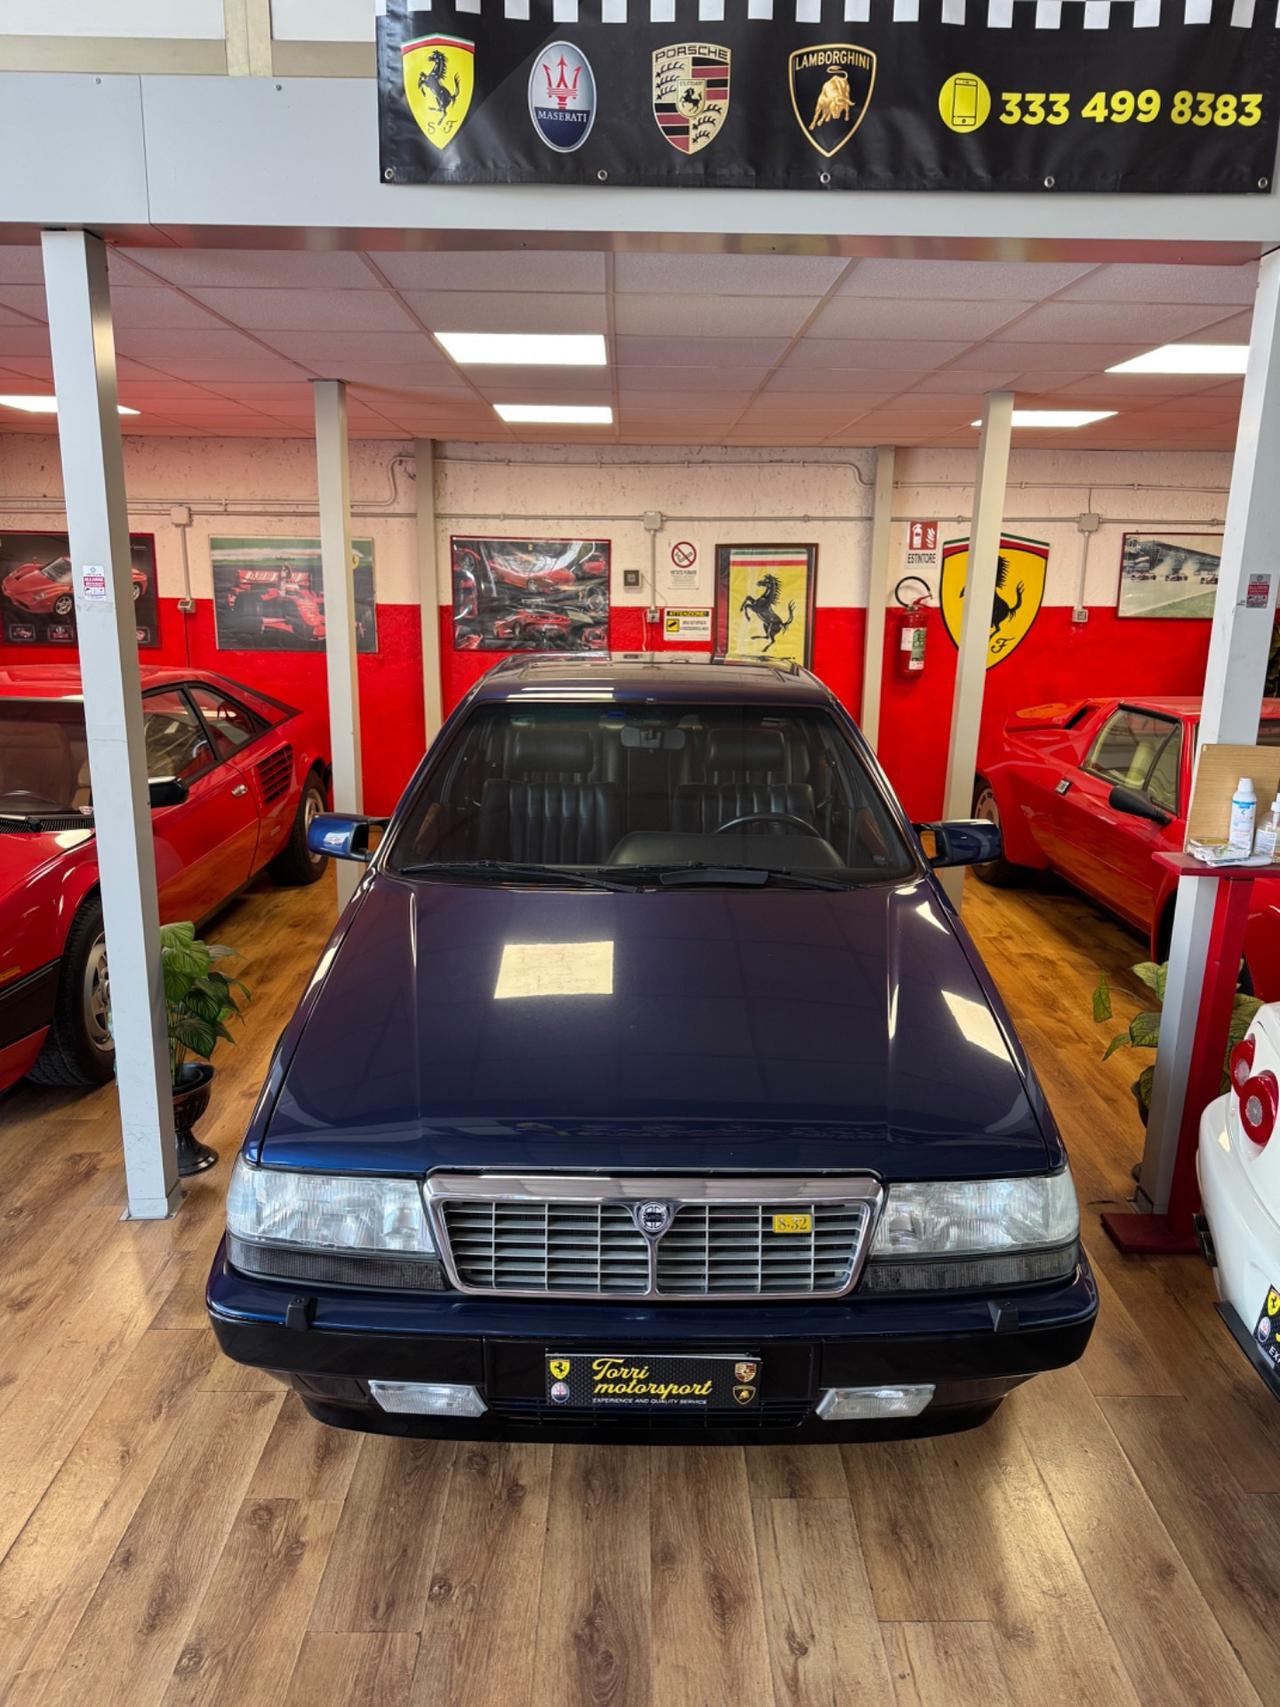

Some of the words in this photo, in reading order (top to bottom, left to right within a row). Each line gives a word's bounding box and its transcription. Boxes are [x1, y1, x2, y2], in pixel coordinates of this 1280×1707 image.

[655, 46, 728, 62] PORSCHE
[795, 50, 870, 71] LAMBORGHINI
[537, 110, 587, 122] MASERATI
[999, 92, 1070, 125] 333
[1081, 89, 1161, 123] 499
[1170, 90, 1263, 126] 8383
[592, 1358, 650, 1380] Torri
[593, 1379, 713, 1400] motorsport
